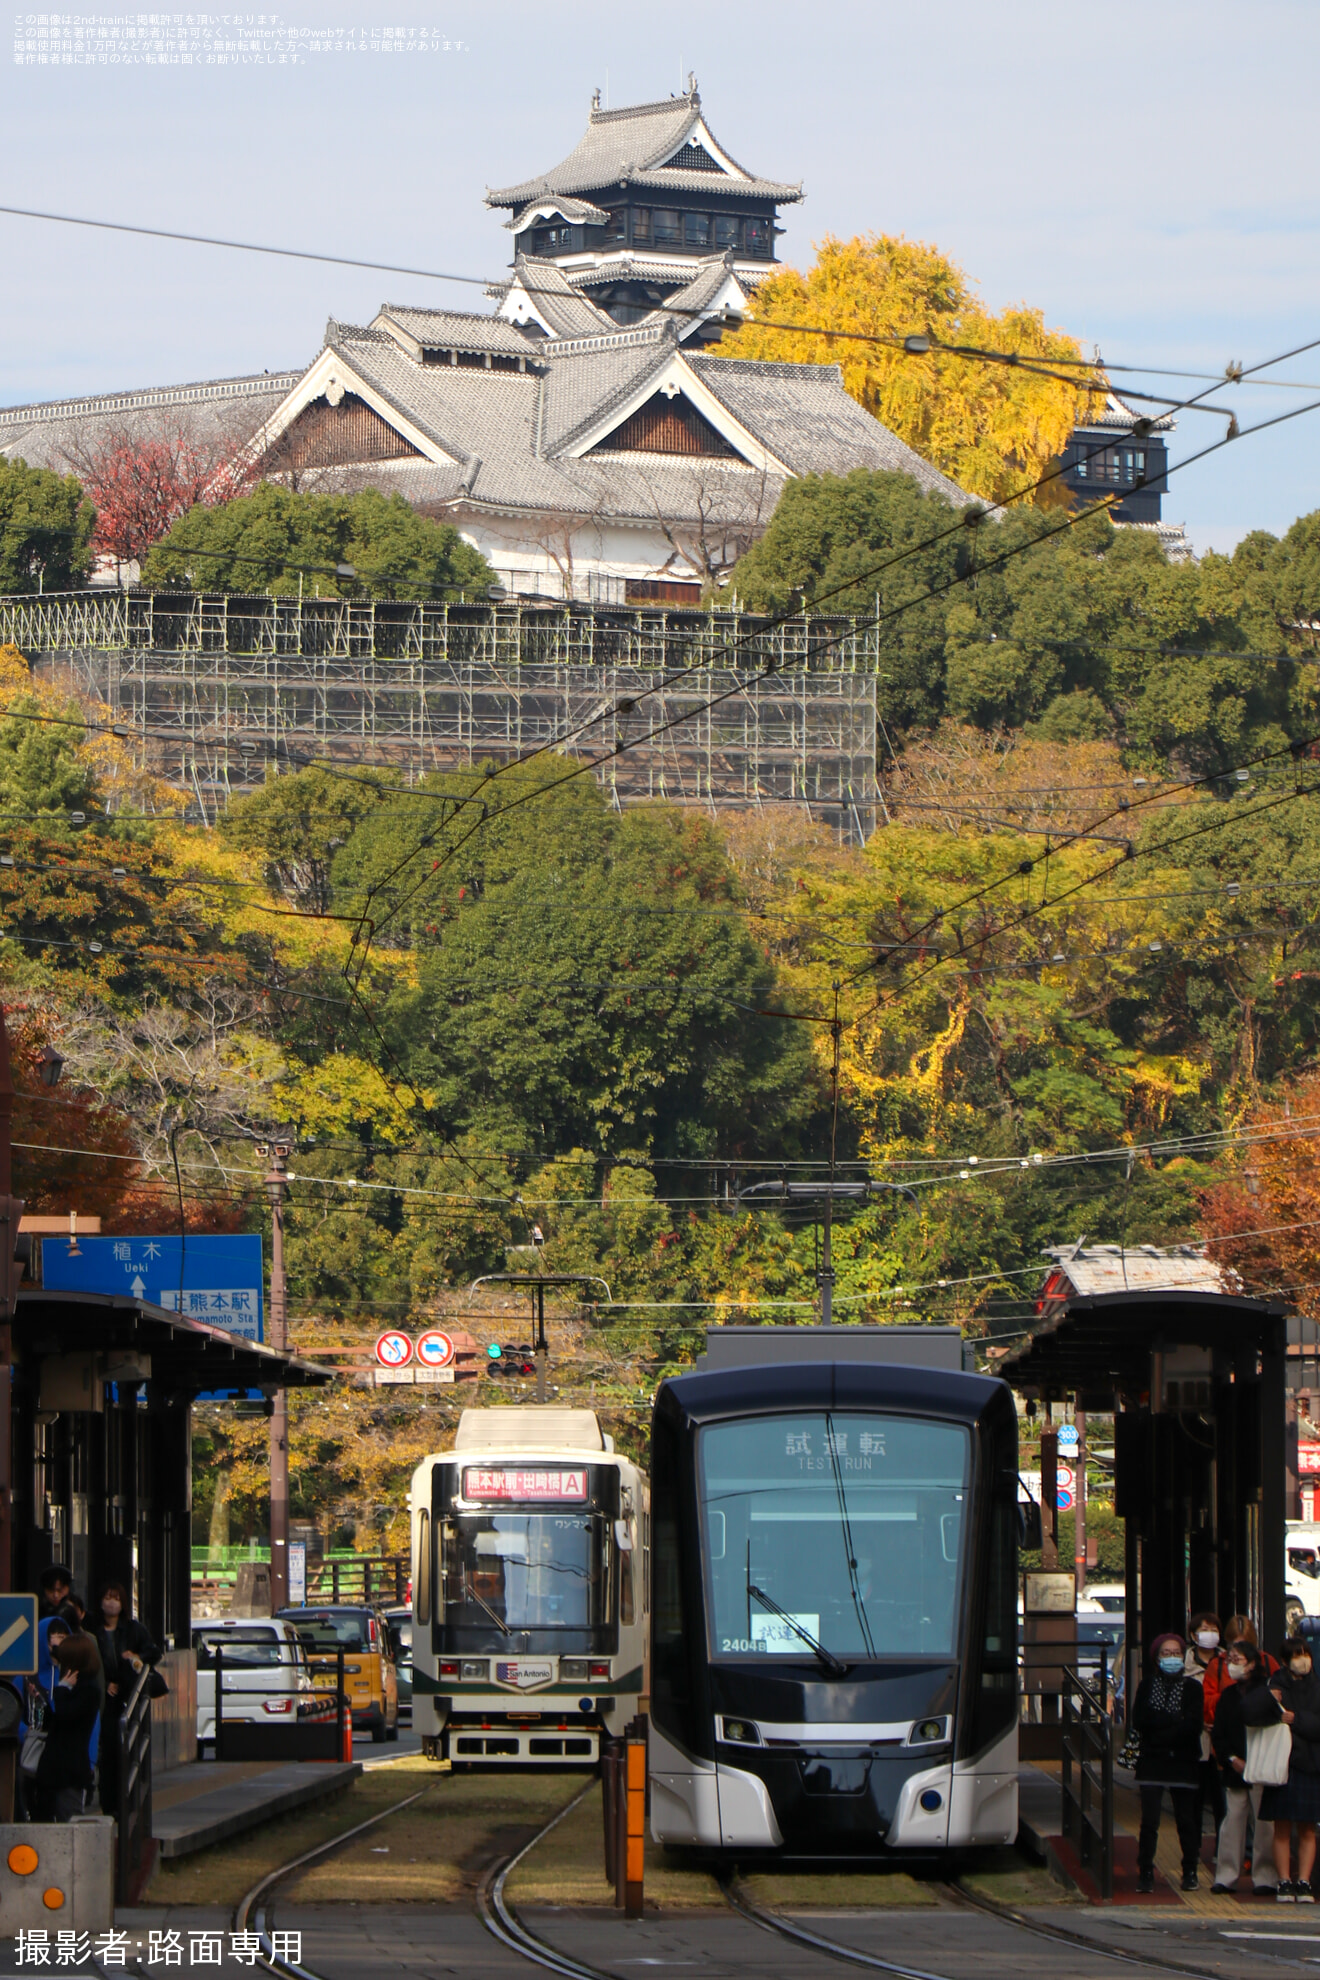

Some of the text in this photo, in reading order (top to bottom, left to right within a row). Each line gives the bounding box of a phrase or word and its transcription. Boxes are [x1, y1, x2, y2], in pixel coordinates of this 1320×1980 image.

[113, 1242, 162, 1261] 植木
[124, 1263, 149, 1273] Ueki
[172, 1291, 251, 1313] 上熊本駅
[238, 1313, 257, 1323] Sta.
[1060, 1431, 1077, 1440] 303
[785, 1431, 887, 1457] 試運転
[799, 1457, 873, 1470] TEST RUN
[565, 1473, 580, 1493] A
[555, 1520, 589, 1529] ワンマン
[510, 1670, 550, 1678] San Antonio
